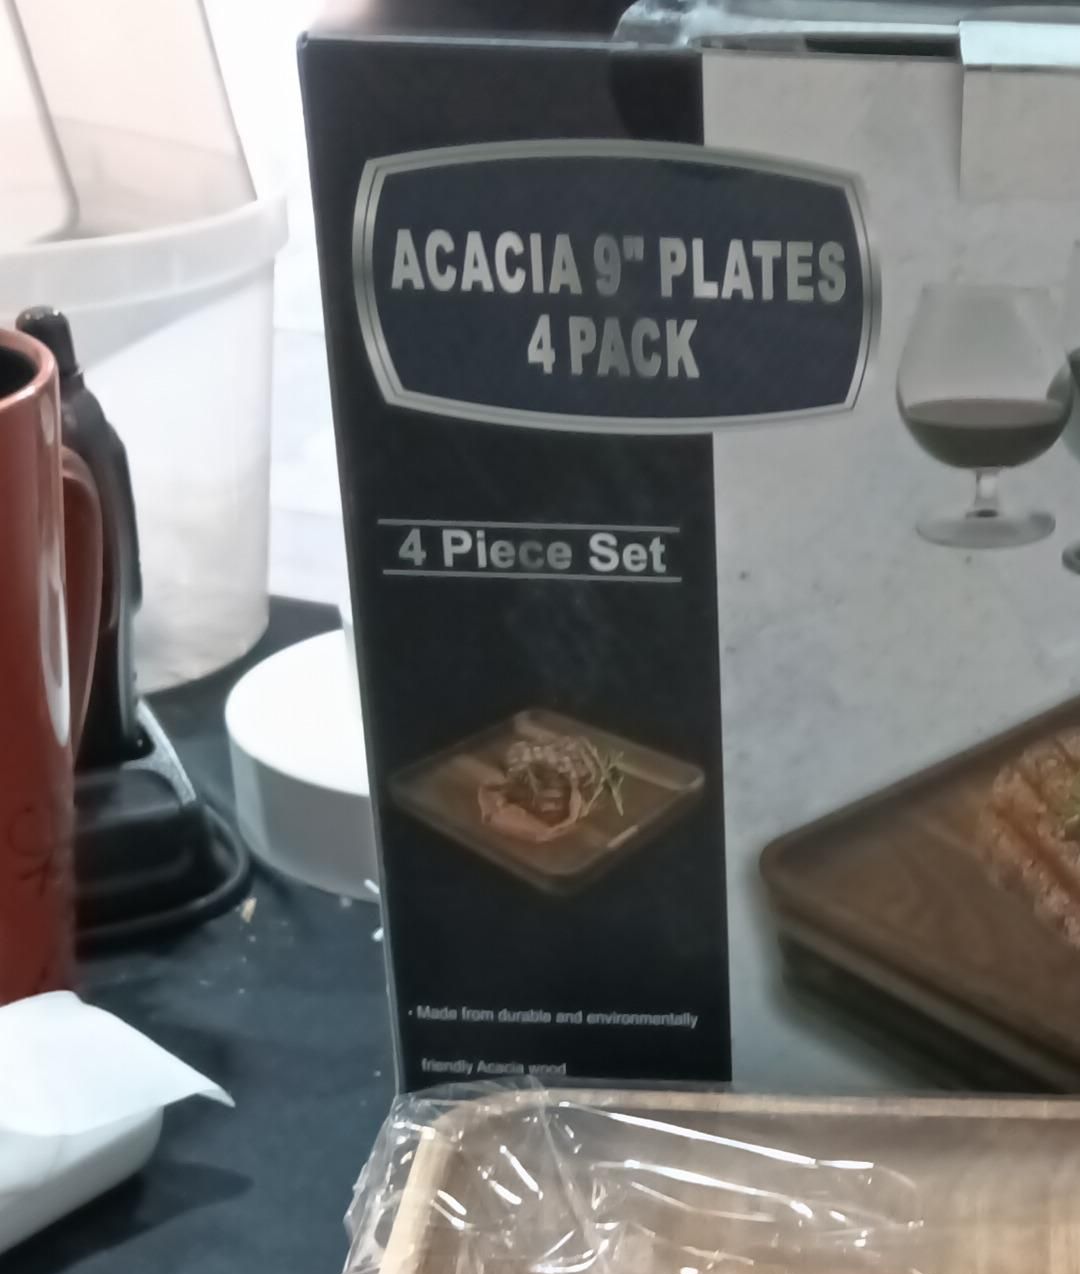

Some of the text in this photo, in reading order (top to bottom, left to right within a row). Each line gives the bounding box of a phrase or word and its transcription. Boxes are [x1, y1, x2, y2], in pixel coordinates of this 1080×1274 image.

[391, 229, 847, 302] ACACIA 9" PLATES
[527, 313, 700, 378] 4 PACK
[398, 528, 667, 573] 4 Piece Set
[417, 1005, 698, 1029] Made from durable and environmentally
[421, 1058, 473, 1075] friendly
[476, 1060, 525, 1075] Acacia
